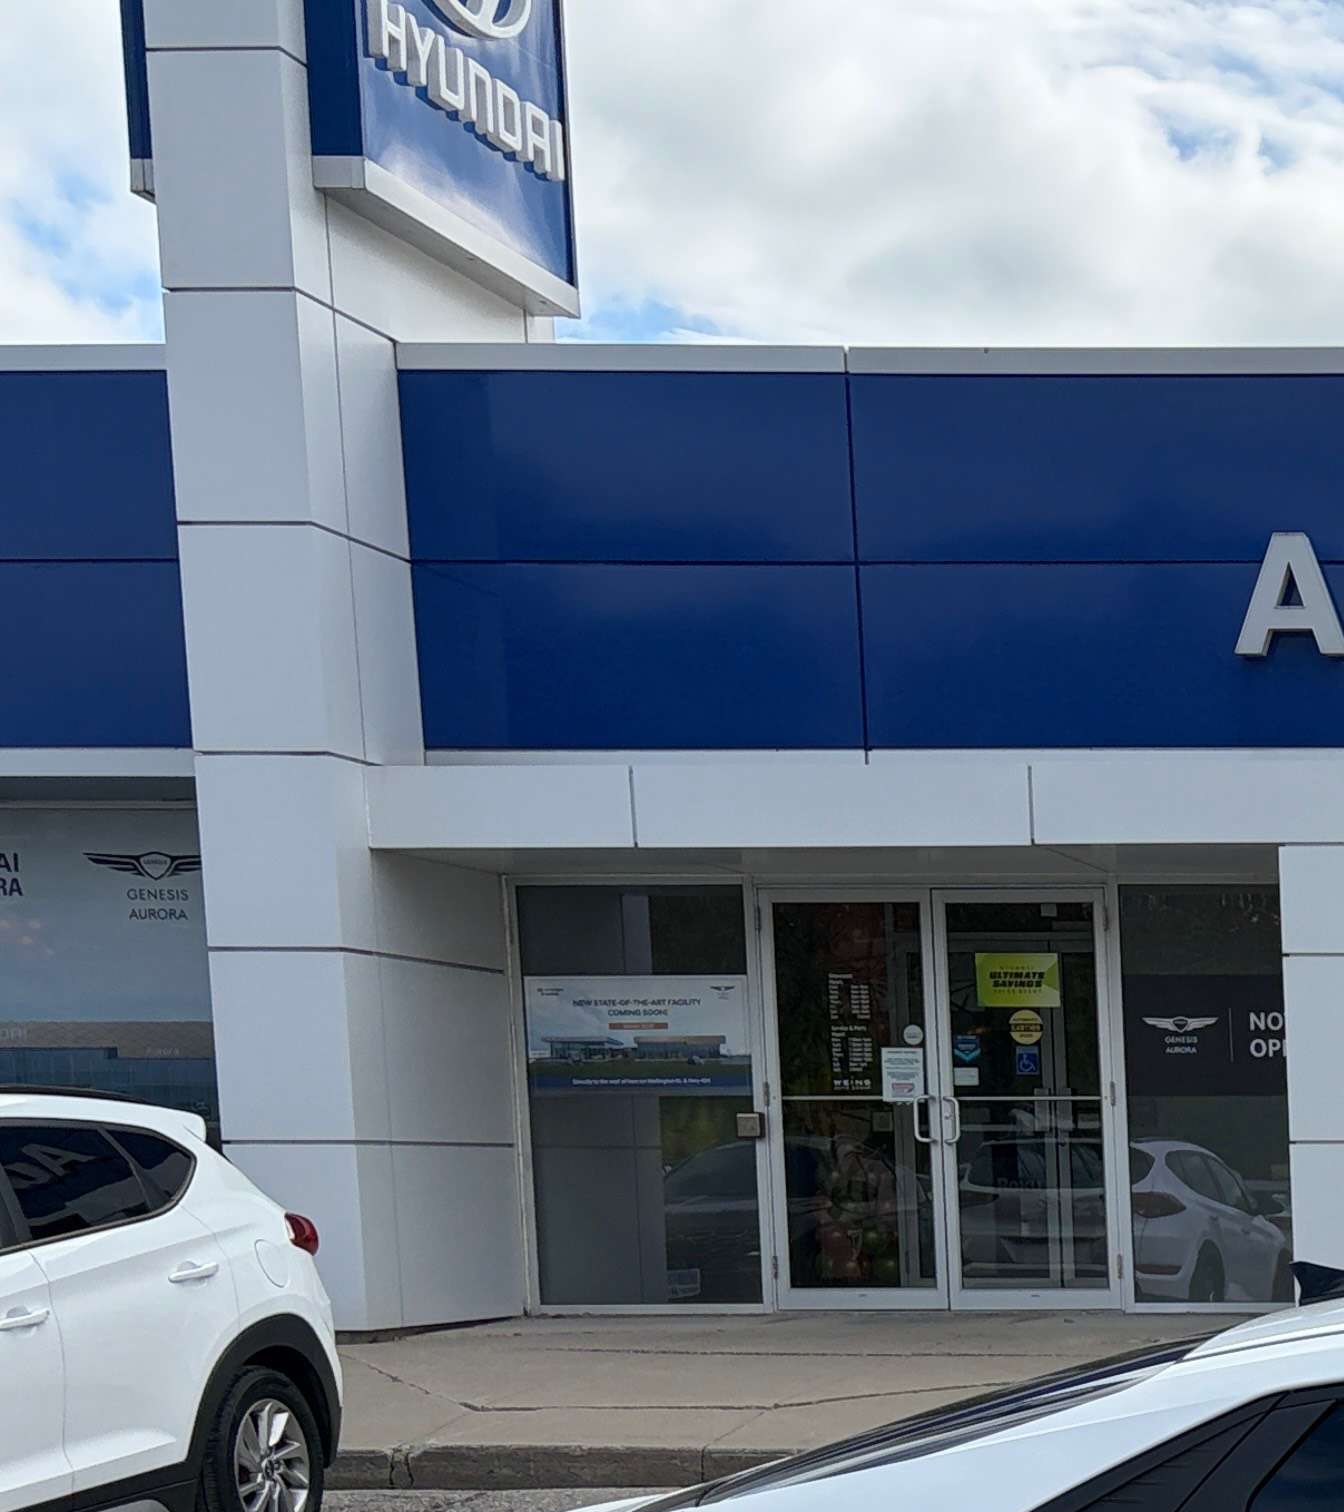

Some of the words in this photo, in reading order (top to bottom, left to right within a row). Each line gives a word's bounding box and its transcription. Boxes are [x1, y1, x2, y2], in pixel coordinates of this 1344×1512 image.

[366, 0, 566, 181] HYUNDAI
[126, 888, 189, 901] GENESIS
[128, 908, 188, 920] AURORA
[1249, 1012, 1286, 1031] NO
[1164, 1035, 1199, 1044] GENESIS
[1165, 1046, 1198, 1055] AURORA
[1249, 1038, 1287, 1058] OP
